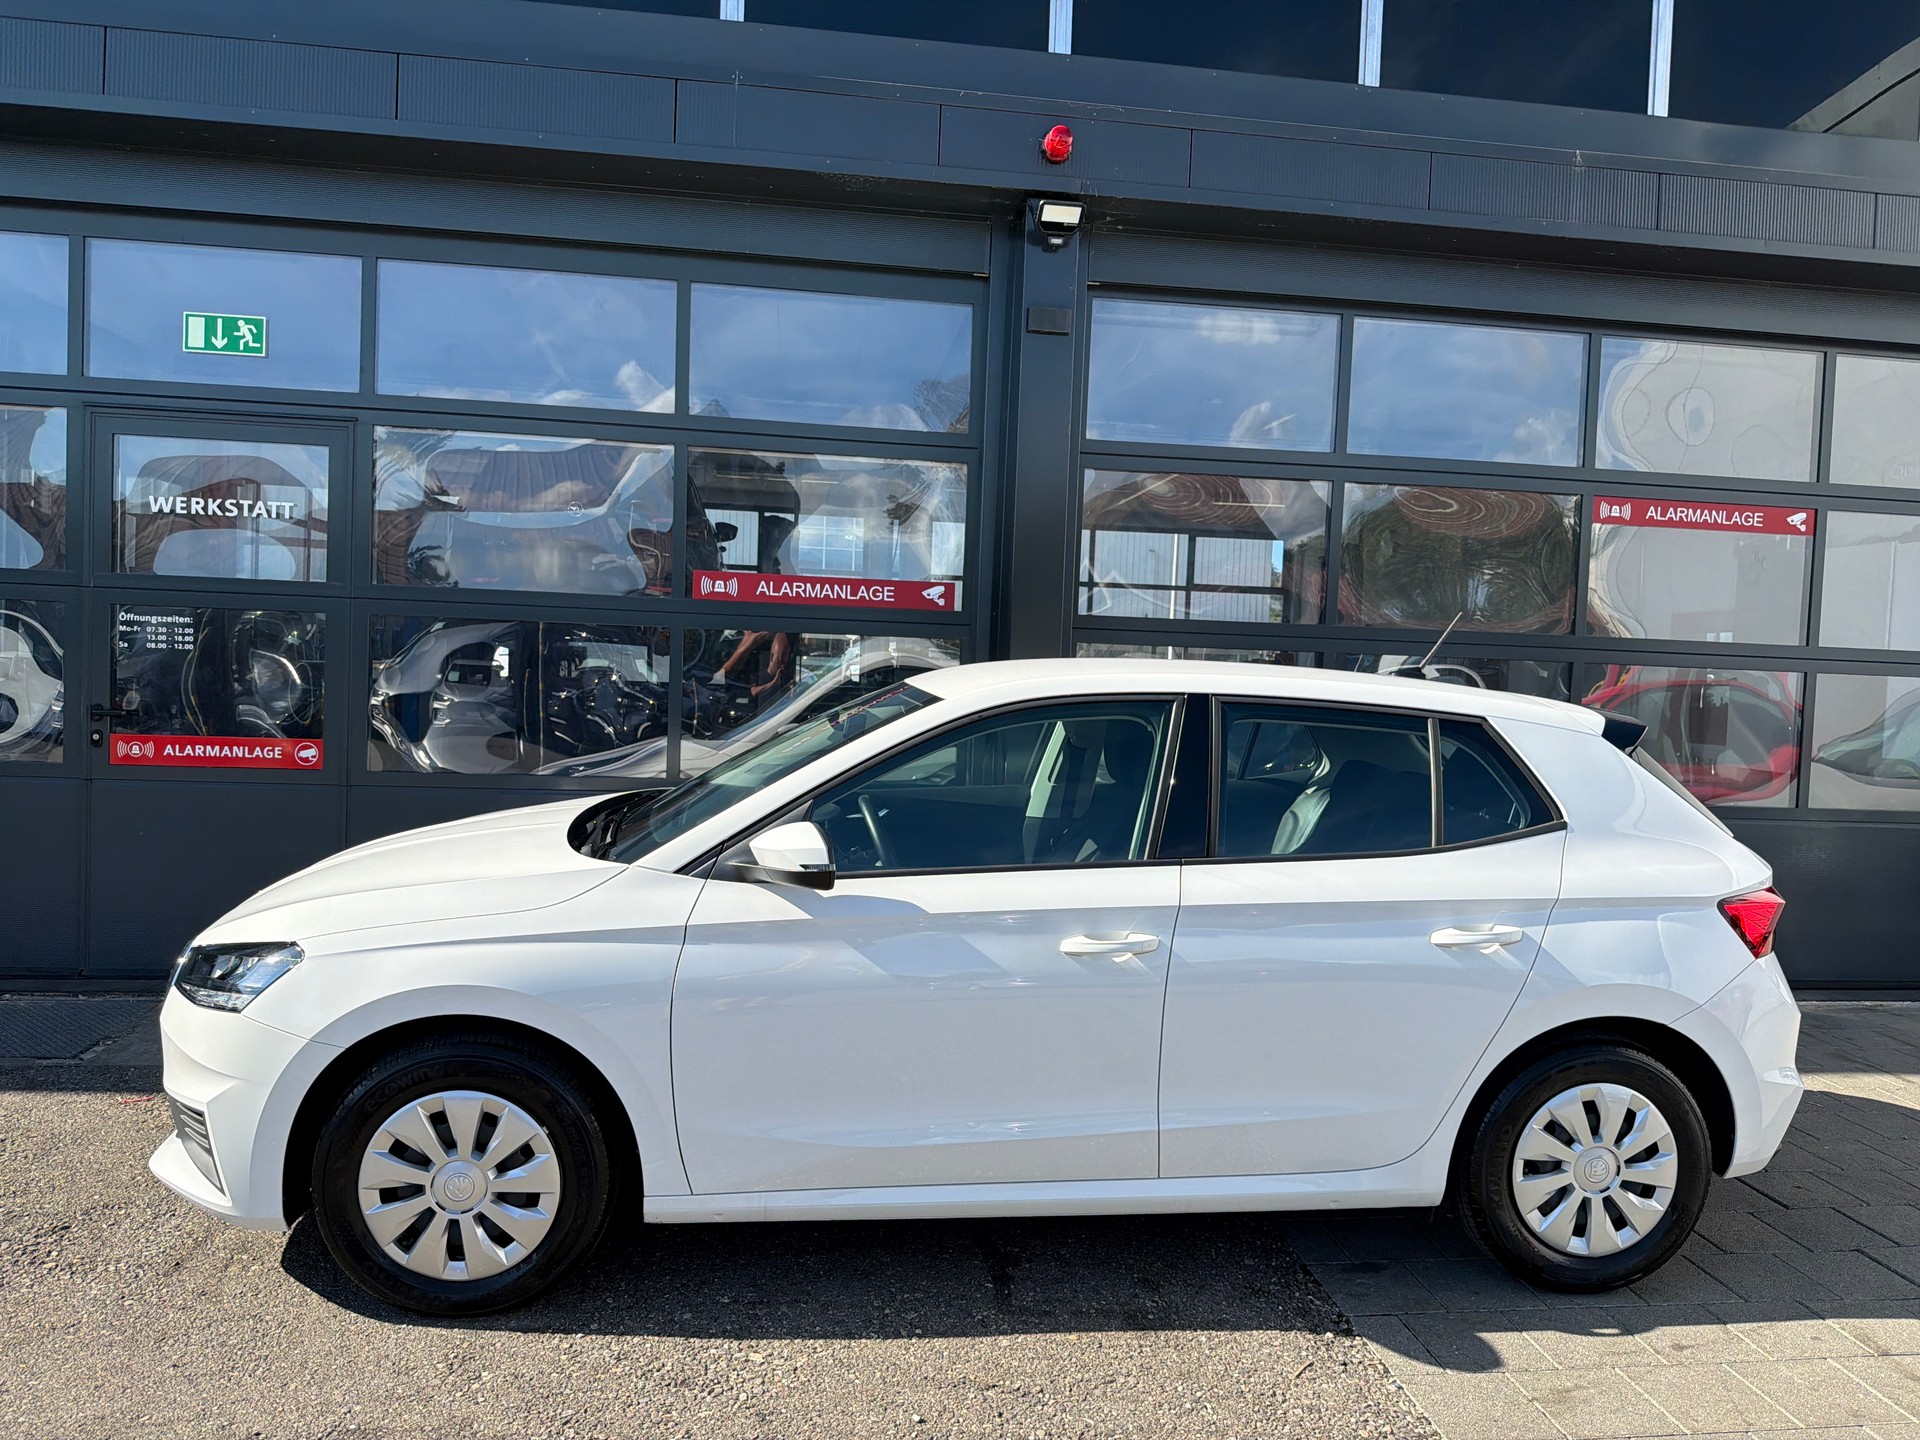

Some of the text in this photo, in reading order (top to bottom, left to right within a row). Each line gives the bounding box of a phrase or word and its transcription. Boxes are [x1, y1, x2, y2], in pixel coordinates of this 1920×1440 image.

[148, 495, 294, 519] WERKSTATT
[1645, 505, 1765, 527] ALARMANLAGE
[755, 580, 896, 602] ALARMANLAGE
[119, 612, 194, 624] Öffnungszeiten:
[162, 743, 284, 759] ALARMANLAGE
